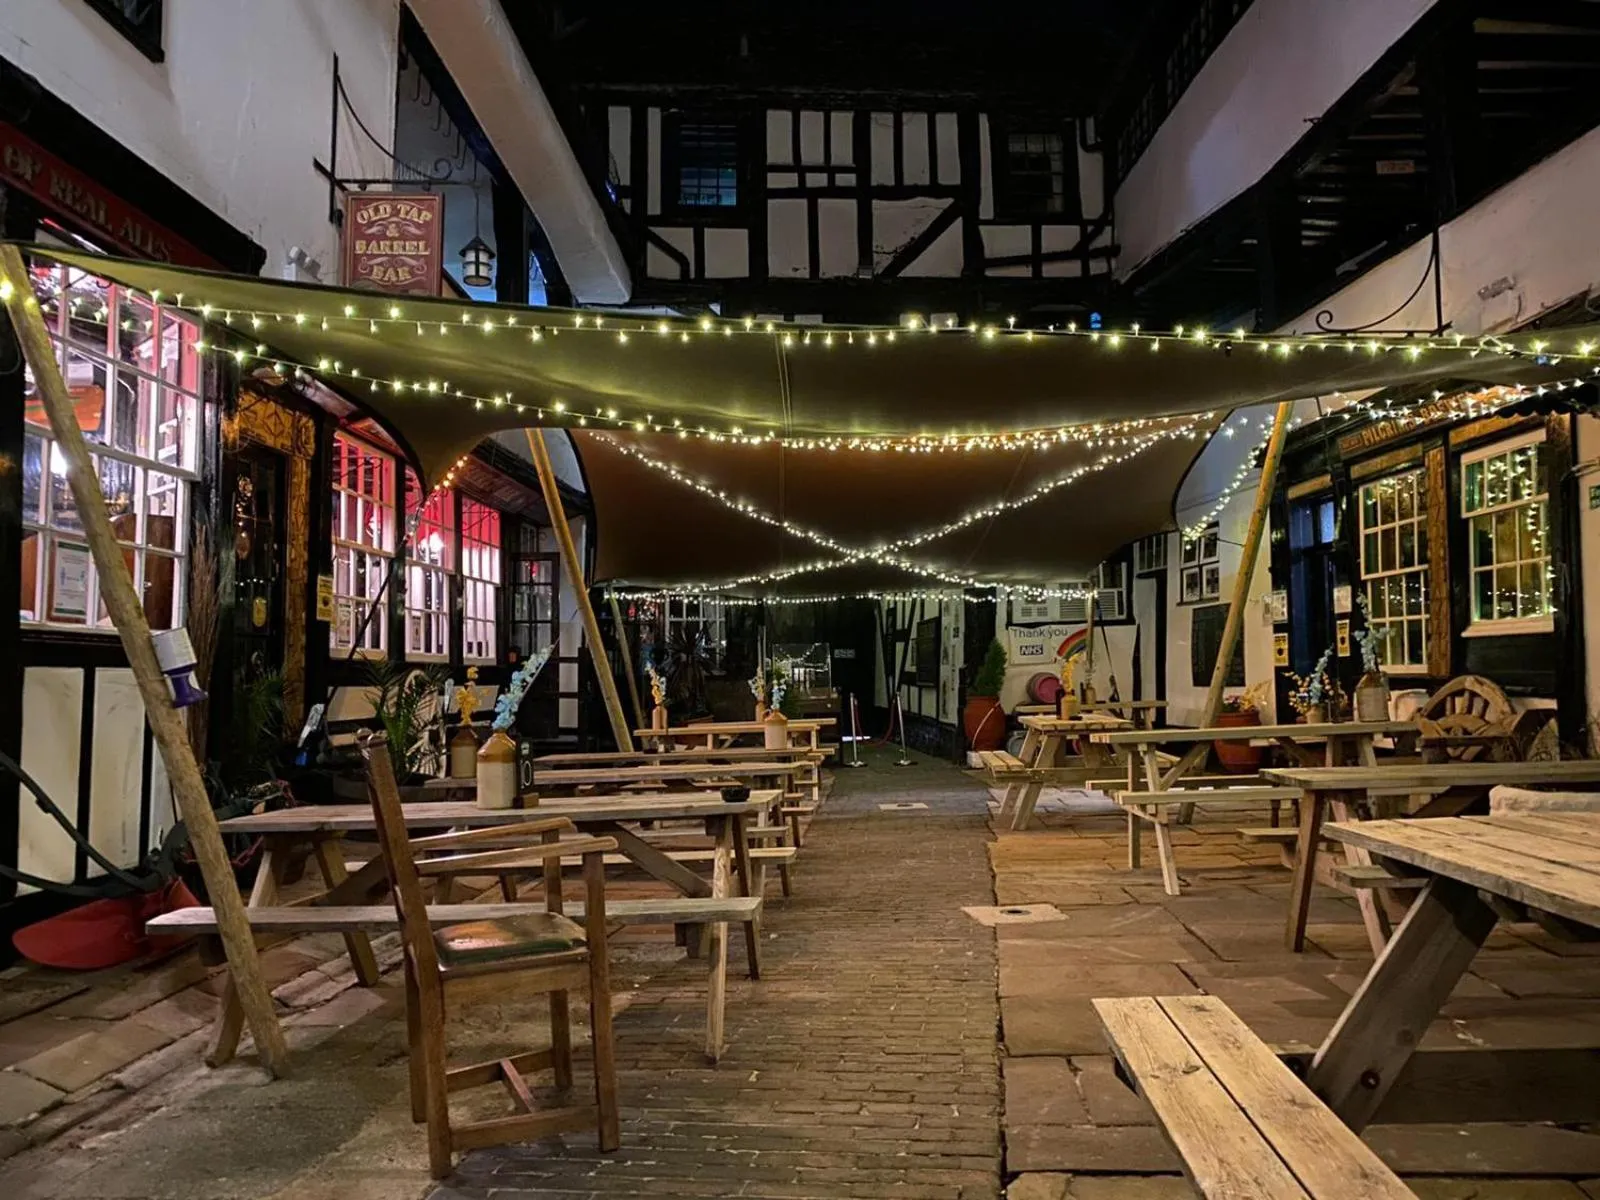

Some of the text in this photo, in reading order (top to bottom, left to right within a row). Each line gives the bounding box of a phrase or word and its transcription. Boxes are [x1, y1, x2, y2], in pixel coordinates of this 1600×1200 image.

[49, 168, 112, 231] REAL
[356, 204, 433, 224] OLD TAP
[386, 223, 400, 237] &
[354, 240, 430, 255] BARREL
[371, 265, 412, 281] BAR
[1010, 627, 1068, 639] Thank you
[1020, 644, 1042, 655] NHS
